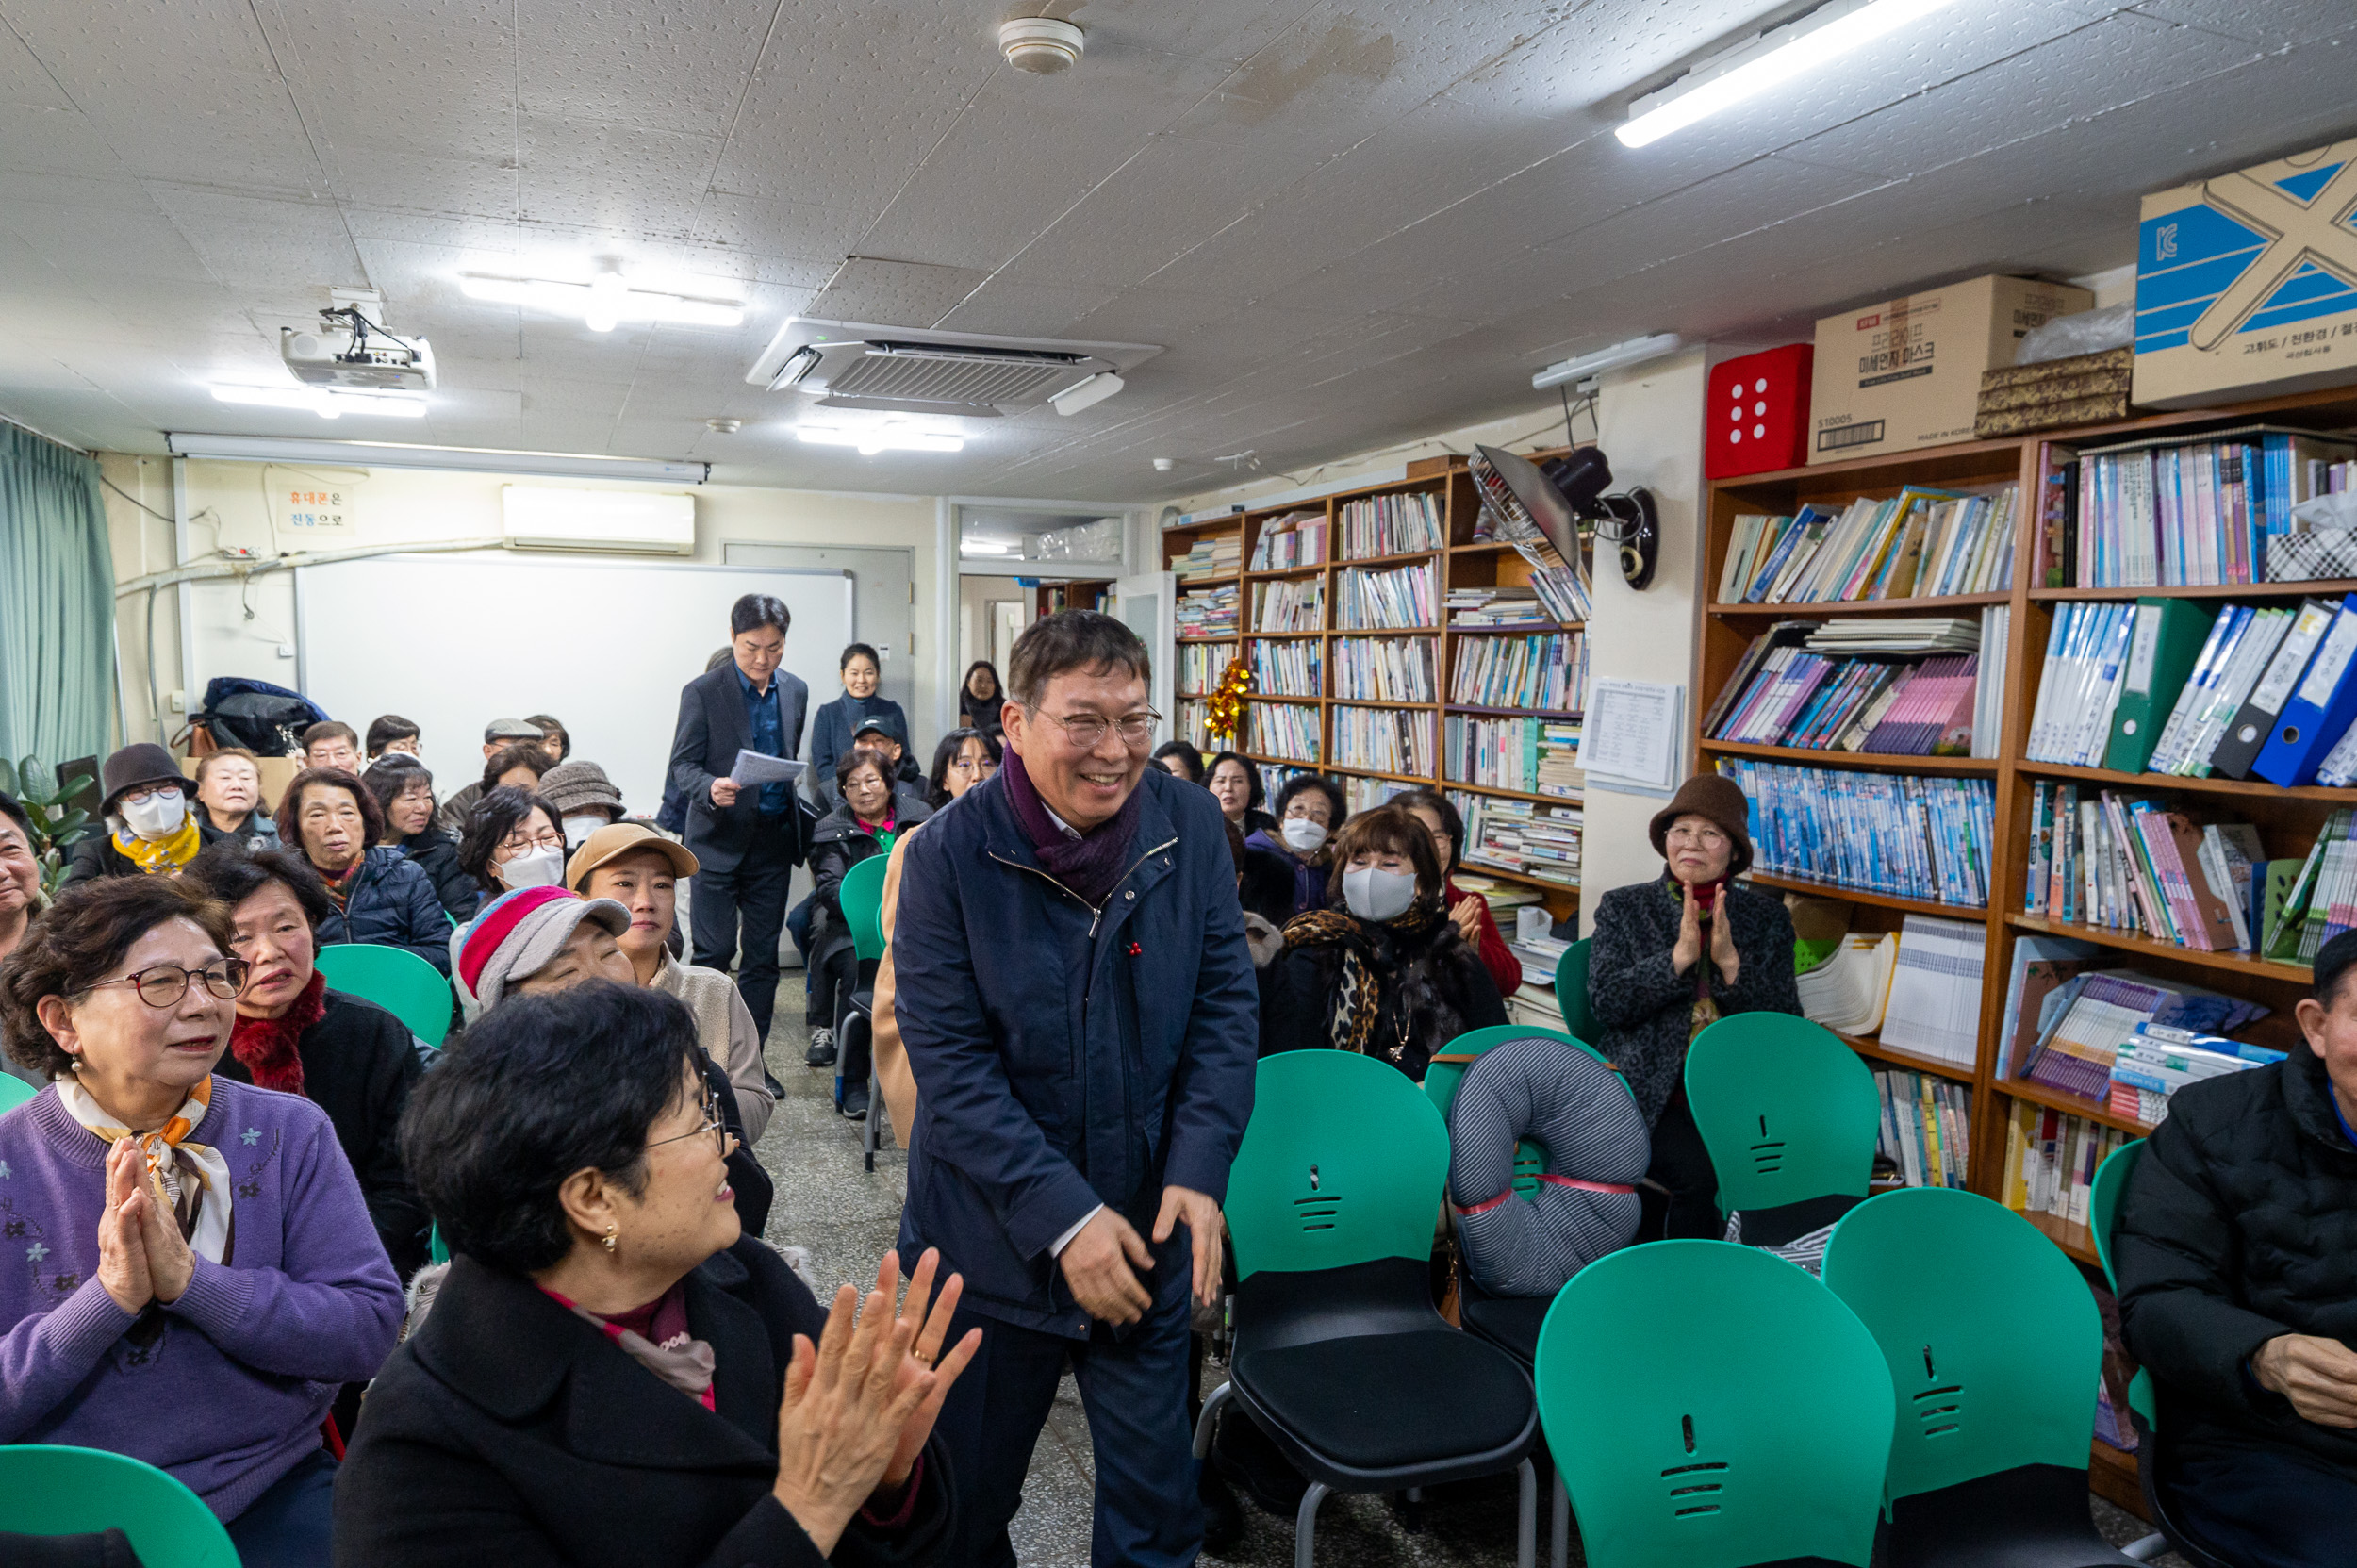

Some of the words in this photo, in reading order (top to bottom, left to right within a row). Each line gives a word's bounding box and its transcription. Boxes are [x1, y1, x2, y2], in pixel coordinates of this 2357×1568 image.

[2292, 328, 2327, 346] 친환경
[1858, 350, 1900, 373] 미세먼지
[1903, 341, 1936, 365] 마스크
[289, 491, 342, 506] 휴대폰은
[290, 513, 344, 527] 진동으로
